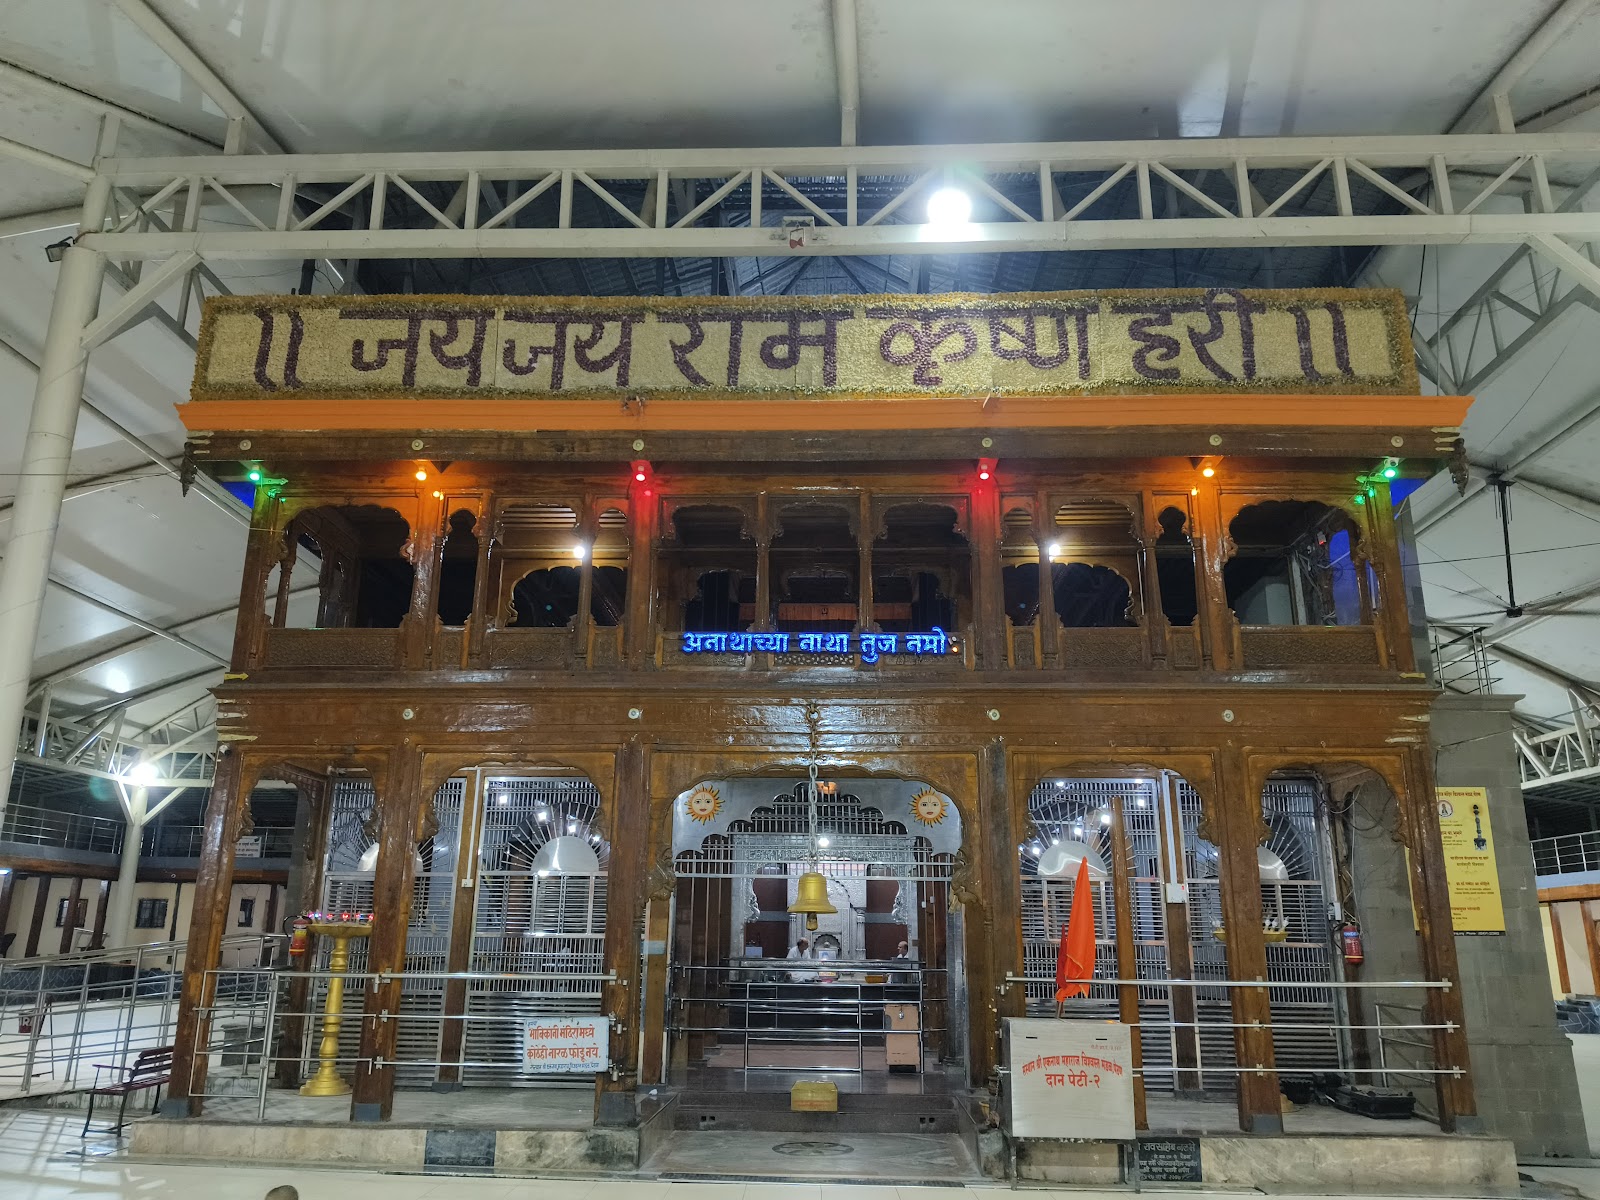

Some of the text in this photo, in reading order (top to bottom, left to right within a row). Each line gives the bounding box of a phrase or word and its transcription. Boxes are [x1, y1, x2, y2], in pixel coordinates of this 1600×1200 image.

[339, 308, 496, 388] जय
[503, 310, 646, 390] जय
[656, 308, 855, 388] राम
[865, 304, 1099, 386] कृष्ण
[1110, 287, 1265, 382] हरी
[682, 626, 947, 663] अनाथाच्या नाथा तुज नमो
[529, 1025, 559, 1040] भाविकांनी
[579, 1024, 595, 1039] मध्ये
[527, 1044, 549, 1060] कोठेही
[548, 1047, 568, 1059] नारळ
[568, 1043, 585, 1062] फोडू
[1043, 1055, 1060, 1070] एकनाथ
[1061, 1055, 1080, 1067] महाराज
[1045, 1074, 1065, 1088] दान
